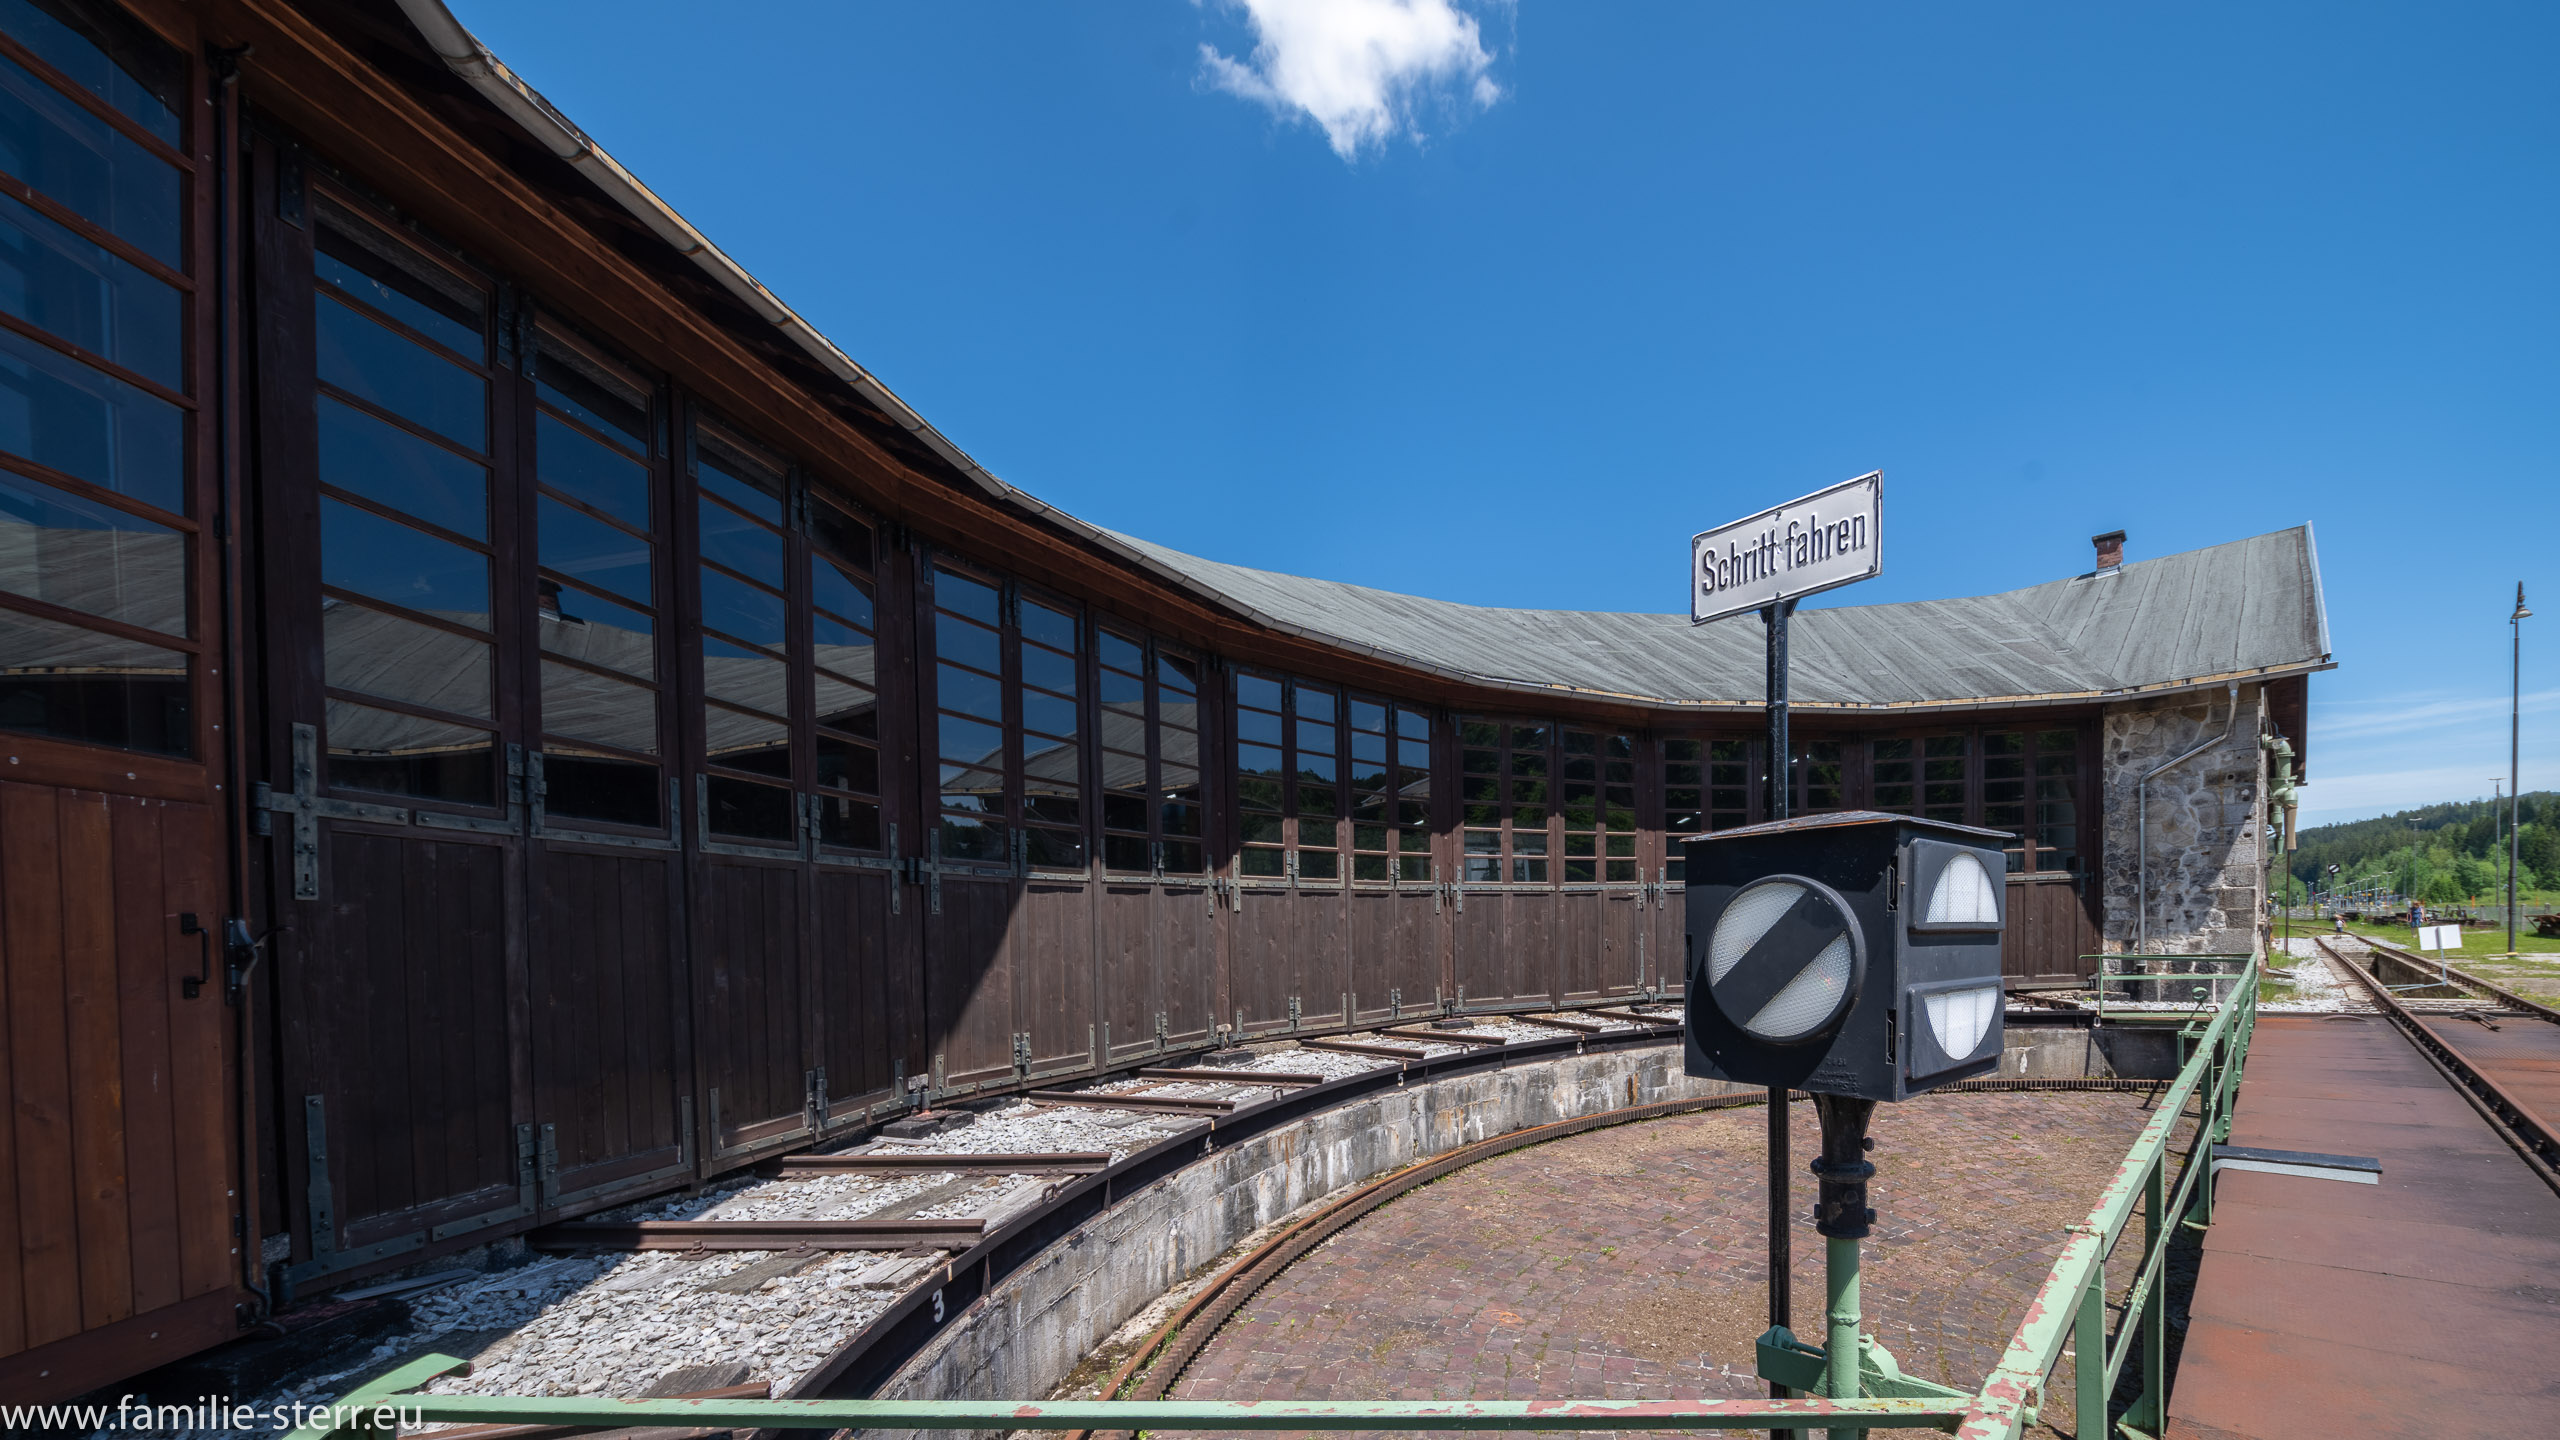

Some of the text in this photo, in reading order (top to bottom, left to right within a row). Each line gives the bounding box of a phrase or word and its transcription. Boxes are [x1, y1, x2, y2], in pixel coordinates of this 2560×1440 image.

[1702, 514, 1866, 593] Schritt fahren
[1576, 1041, 1583, 1055] 6
[1397, 1071, 1404, 1087] 5
[931, 1287, 945, 1323] 3
